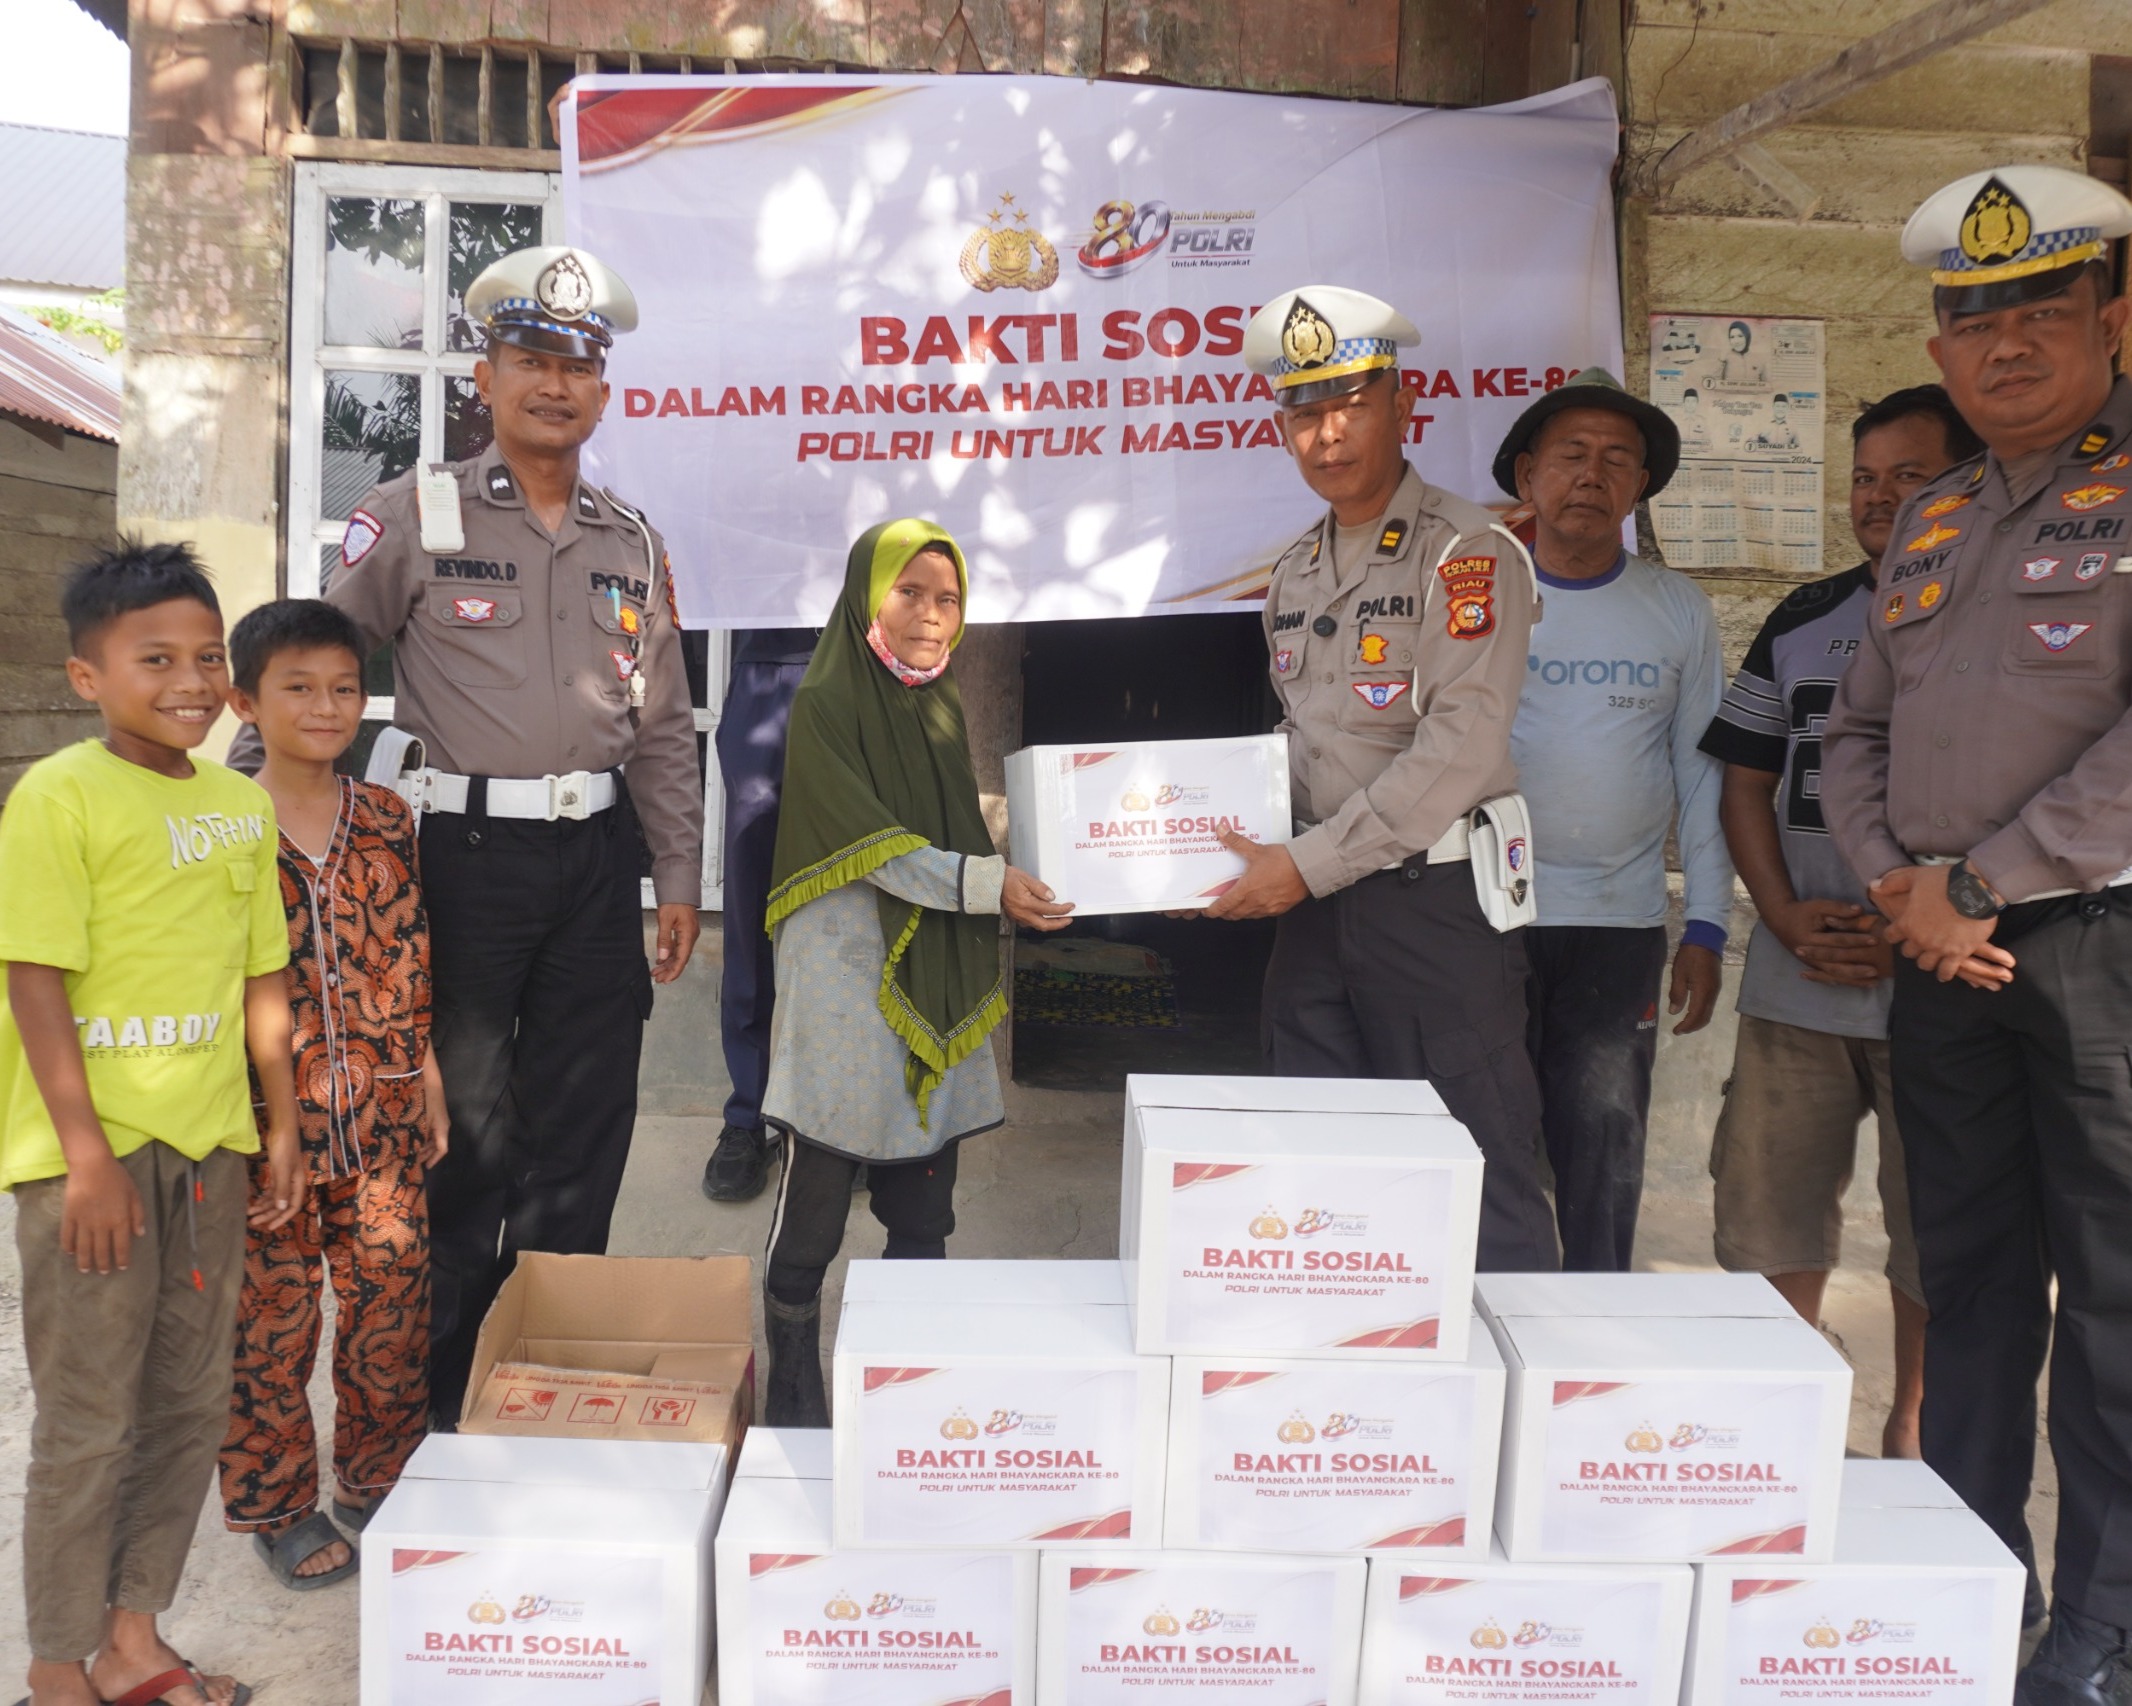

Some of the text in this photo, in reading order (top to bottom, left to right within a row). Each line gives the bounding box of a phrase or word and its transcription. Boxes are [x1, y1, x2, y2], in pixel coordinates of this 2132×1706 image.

[1203, 209, 1255, 222] Mengabdi
[1170, 228, 1255, 253] POLRI
[1171, 259, 1250, 268] Untuk Masyarakat
[860, 305, 1263, 365] BAKTI SOS
[624, 386, 787, 418] DALAM
[801, 383, 990, 416] RANGKA
[1002, 378, 1107, 411] HARI
[797, 430, 933, 462] POLRI
[950, 425, 1113, 461] UNTUK
[1791, 456, 1812, 464] 2024
[2034, 518, 2124, 544] POLRI
[1891, 551, 1951, 583] BONY
[1452, 580, 1486, 591] RIAU
[1356, 595, 1413, 619] POLRI
[1608, 695, 1635, 709] 325
[1089, 815, 1245, 838] BAKTI SOSIAL
[165, 812, 268, 870] NOTHIN
[1075, 841, 1106, 849] DALAM
[1109, 839, 1144, 847] RANGKA
[1170, 836, 1219, 844] BHAYANGK
[1108, 846, 1228, 858] POLRI UNTUK MASYARAKAT
[1203, 1248, 1412, 1272] BAKTI SOSIAL
[1183, 1270, 1223, 1279] DALAM
[1227, 1272, 1274, 1281] RANGKA
[1308, 1274, 1393, 1283] BHAYANGKARA
[1397, 1276, 1429, 1284] KE-80
[1225, 1285, 1385, 1296] POLRI UNTUK MASYARAKAT
[897, 1449, 1102, 1469] BAKTI SOSIAL
[1234, 1453, 1437, 1473] BAKTI SOSIAL
[1580, 1461, 1781, 1482] BAKTI SOSIAL
[1215, 1474, 1254, 1483] DALAM
[1258, 1476, 1303, 1484] RANGKA
[1337, 1476, 1419, 1484] BHAYANGKARA
[919, 1484, 953, 1492] POLRI
[1294, 1489, 1331, 1497] UNTUK
[1603, 1484, 1648, 1492] RANGKA
[1767, 1485, 1797, 1493] KE-80
[425, 1632, 629, 1657] BAKTI SOSIAL
[784, 1630, 981, 1648] BAKTI SOSIAL
[406, 1654, 445, 1662] DALAM
[449, 1656, 495, 1664] RANGKA
[499, 1657, 525, 1665] HARI
[529, 1659, 612, 1667] BHAYANGKARA
[1101, 1645, 1299, 1664] BAKTI SOSIAL
[1124, 1666, 1168, 1674] RANGKA
[1426, 1655, 1622, 1678] BAKTI SOSIAL
[1759, 1657, 1958, 1675] BAKTI SOSIAL
[447, 1668, 605, 1680] POLRI UNTUK MASYARAKAT
[1122, 1678, 1154, 1686] POLRI
[1406, 1676, 1445, 1684] DALAM
[1448, 1679, 1493, 1687] RANGKA
[1496, 1680, 1521, 1688] HARI
[1740, 1678, 1779, 1686] DALAM
[1446, 1691, 1478, 1699] POLRI
[1482, 1692, 1519, 1700] UNTUK
[1817, 1690, 1854, 1698] UNTUK
